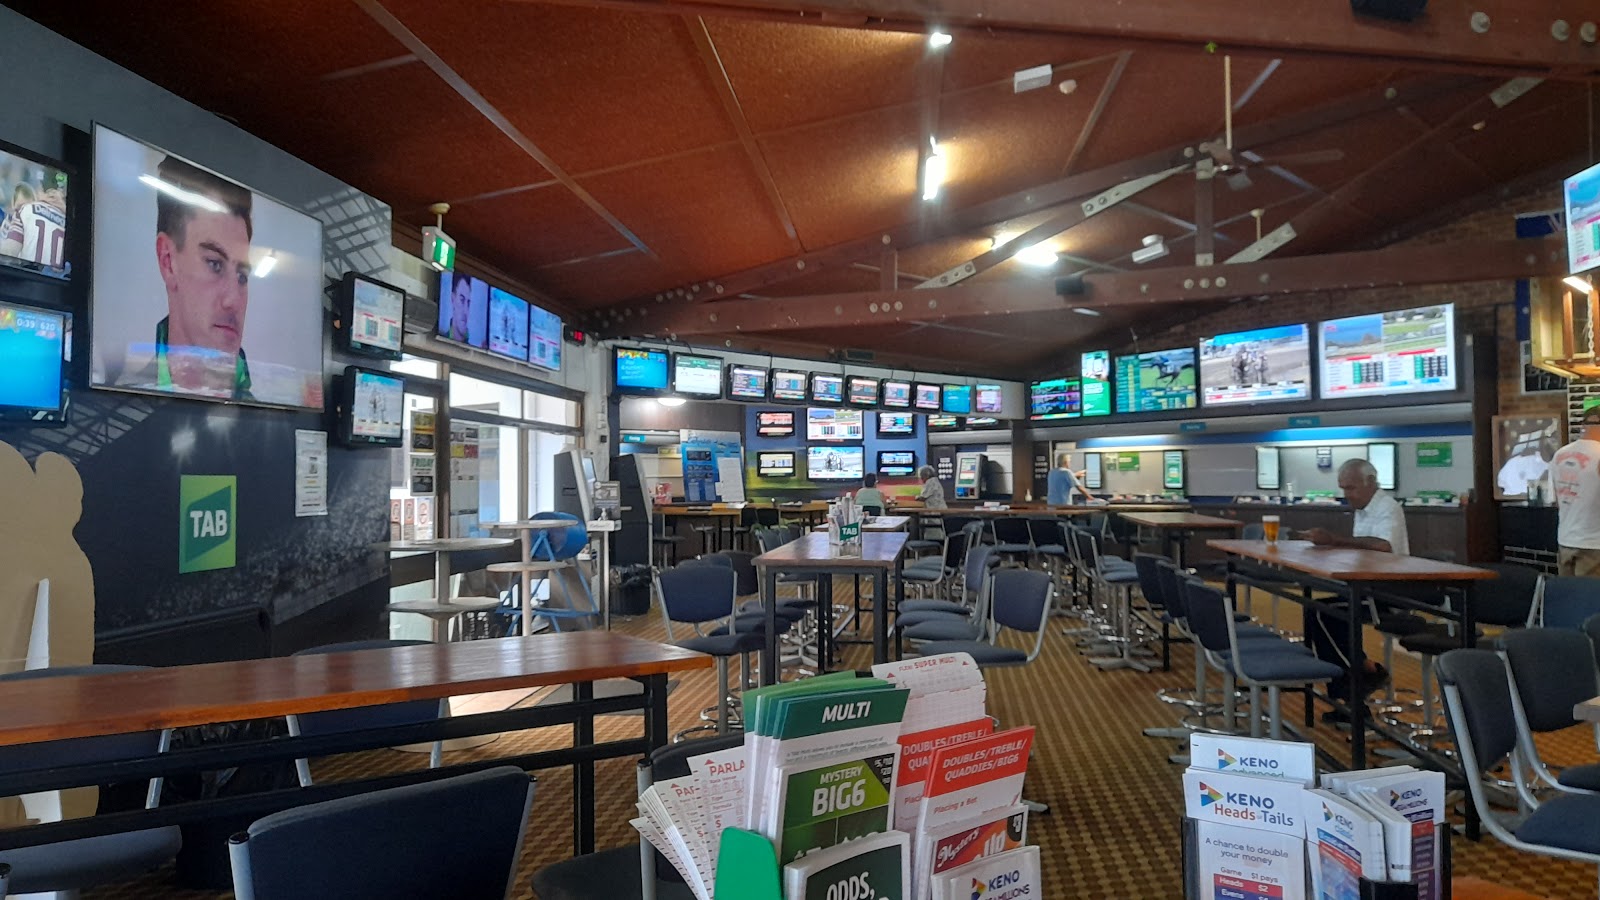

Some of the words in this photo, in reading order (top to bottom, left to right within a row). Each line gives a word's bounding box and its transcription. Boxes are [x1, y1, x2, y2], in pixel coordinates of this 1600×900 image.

[190, 509, 228, 538] TAB
[842, 527, 857, 535] TAB
[914, 658, 937, 669] SUPER
[822, 701, 871, 723] MULTI
[945, 754, 1020, 782] QUADDIES/BIG6
[1240, 757, 1279, 769] KENO
[820, 766, 864, 784] MYSTERY
[812, 779, 866, 817] BIG6
[1226, 792, 1275, 809] KENO
[1214, 803, 1256, 821] Heads
[1261, 810, 1294, 827] Tails
[1205, 837, 1212, 845] A
[1213, 839, 1245, 851] chance
[1246, 844, 1256, 853] to
[1257, 846, 1289, 858] double
[1220, 850, 1241, 859] your
[1242, 853, 1273, 866] money
[989, 870, 1020, 892] KENO
[1219, 877, 1245, 888] Heads
[1220, 866, 1243, 877] Game
[1260, 875, 1279, 884] pays
[826, 872, 875, 900] ODDS,
